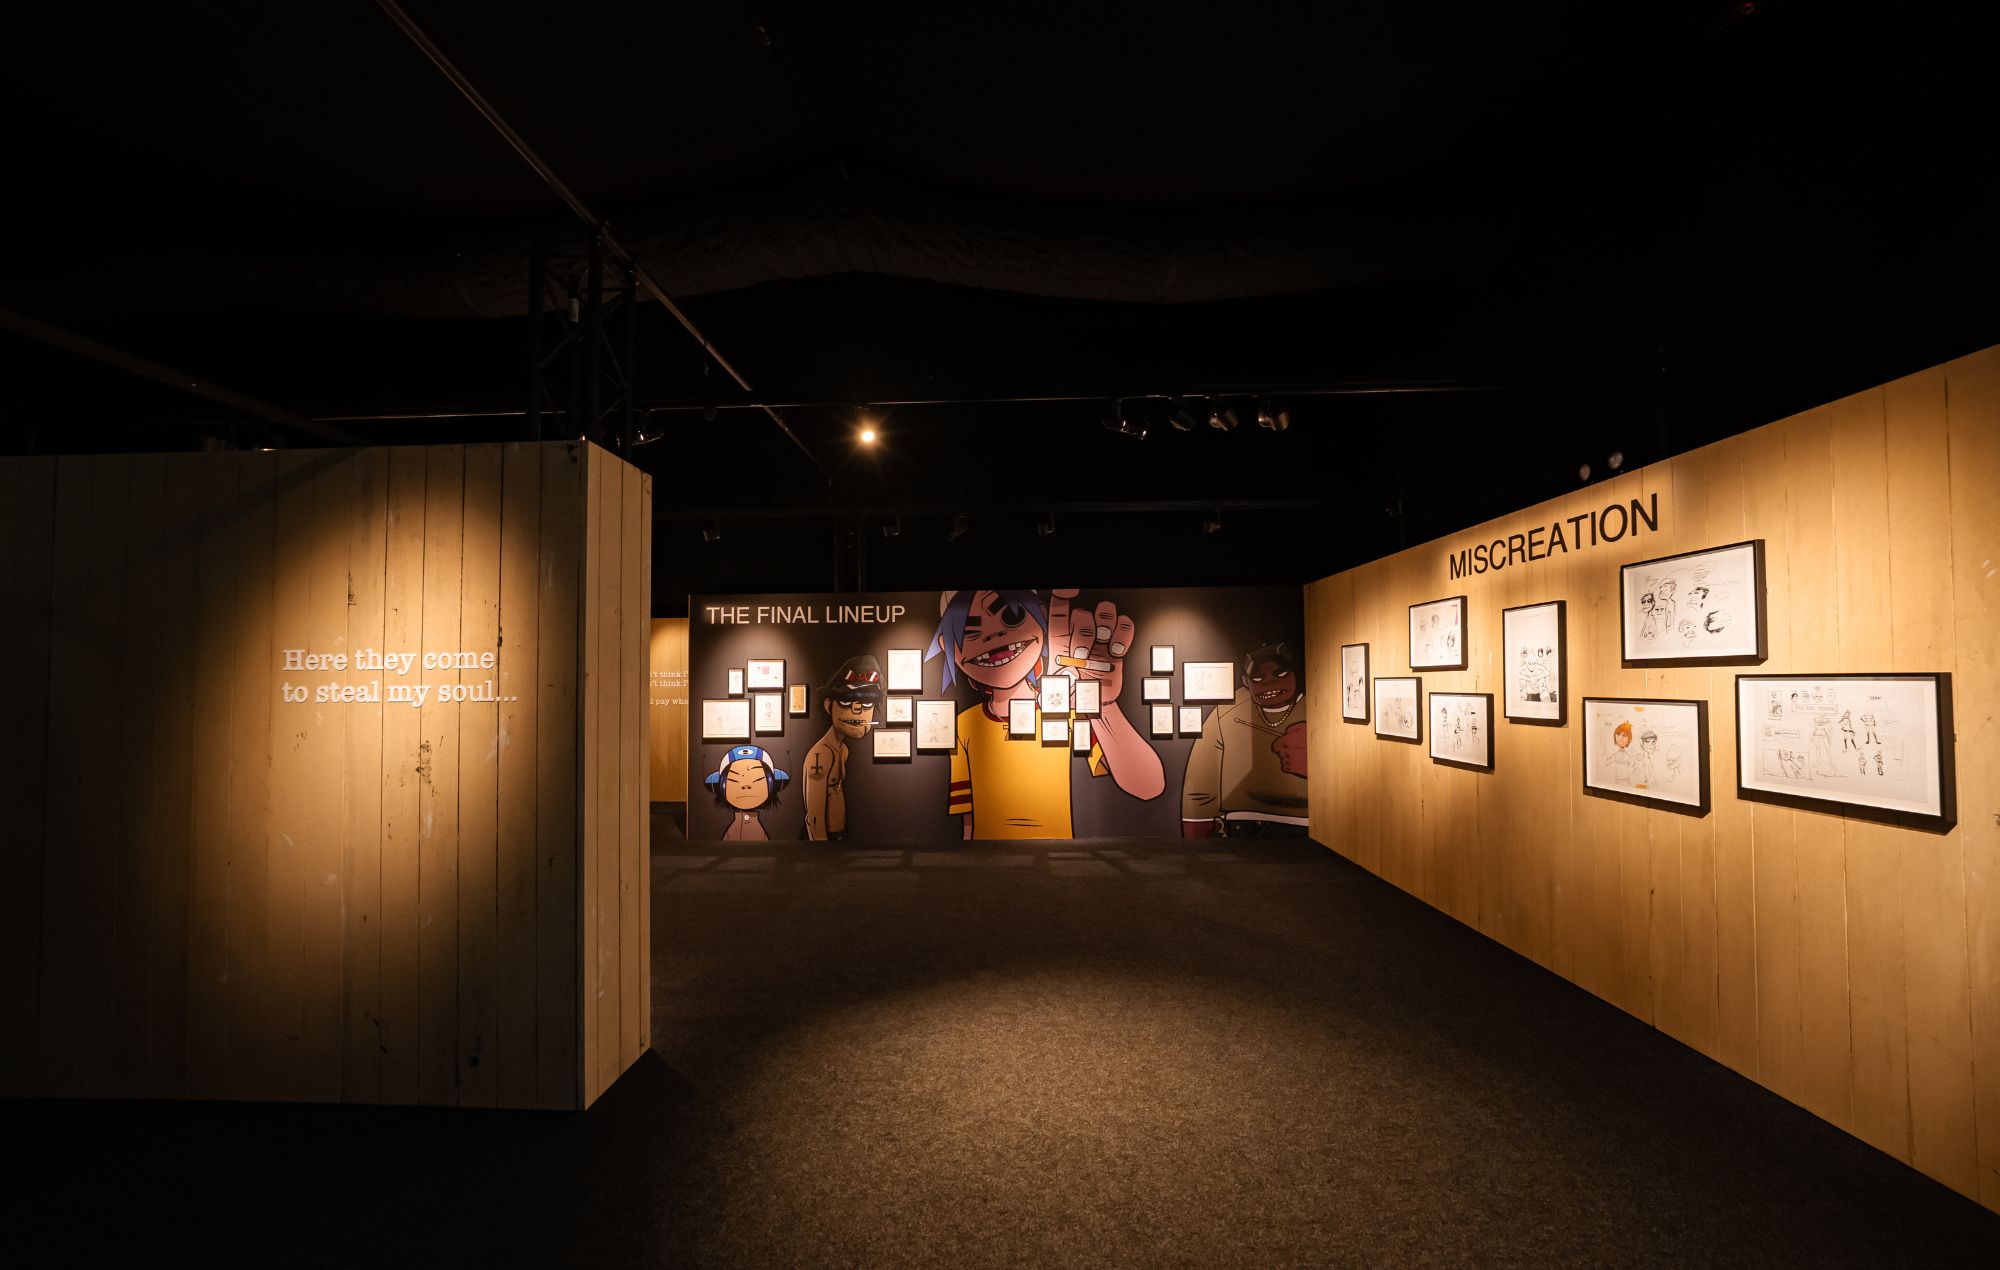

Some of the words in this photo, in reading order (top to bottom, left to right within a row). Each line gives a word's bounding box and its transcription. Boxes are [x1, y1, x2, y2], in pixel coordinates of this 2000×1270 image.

[1450, 493, 1658, 580] MISCREATION
[706, 606, 750, 624] THE
[757, 606, 819, 624] FINAL
[826, 605, 906, 624] LINEUP
[282, 649, 348, 671] Here
[354, 649, 417, 675] they
[423, 651, 495, 670] come
[282, 681, 309, 703] to
[315, 680, 380, 703] steal
[386, 683, 431, 707] my
[438, 680, 517, 702] soul...
[655, 698, 670, 706] pay
